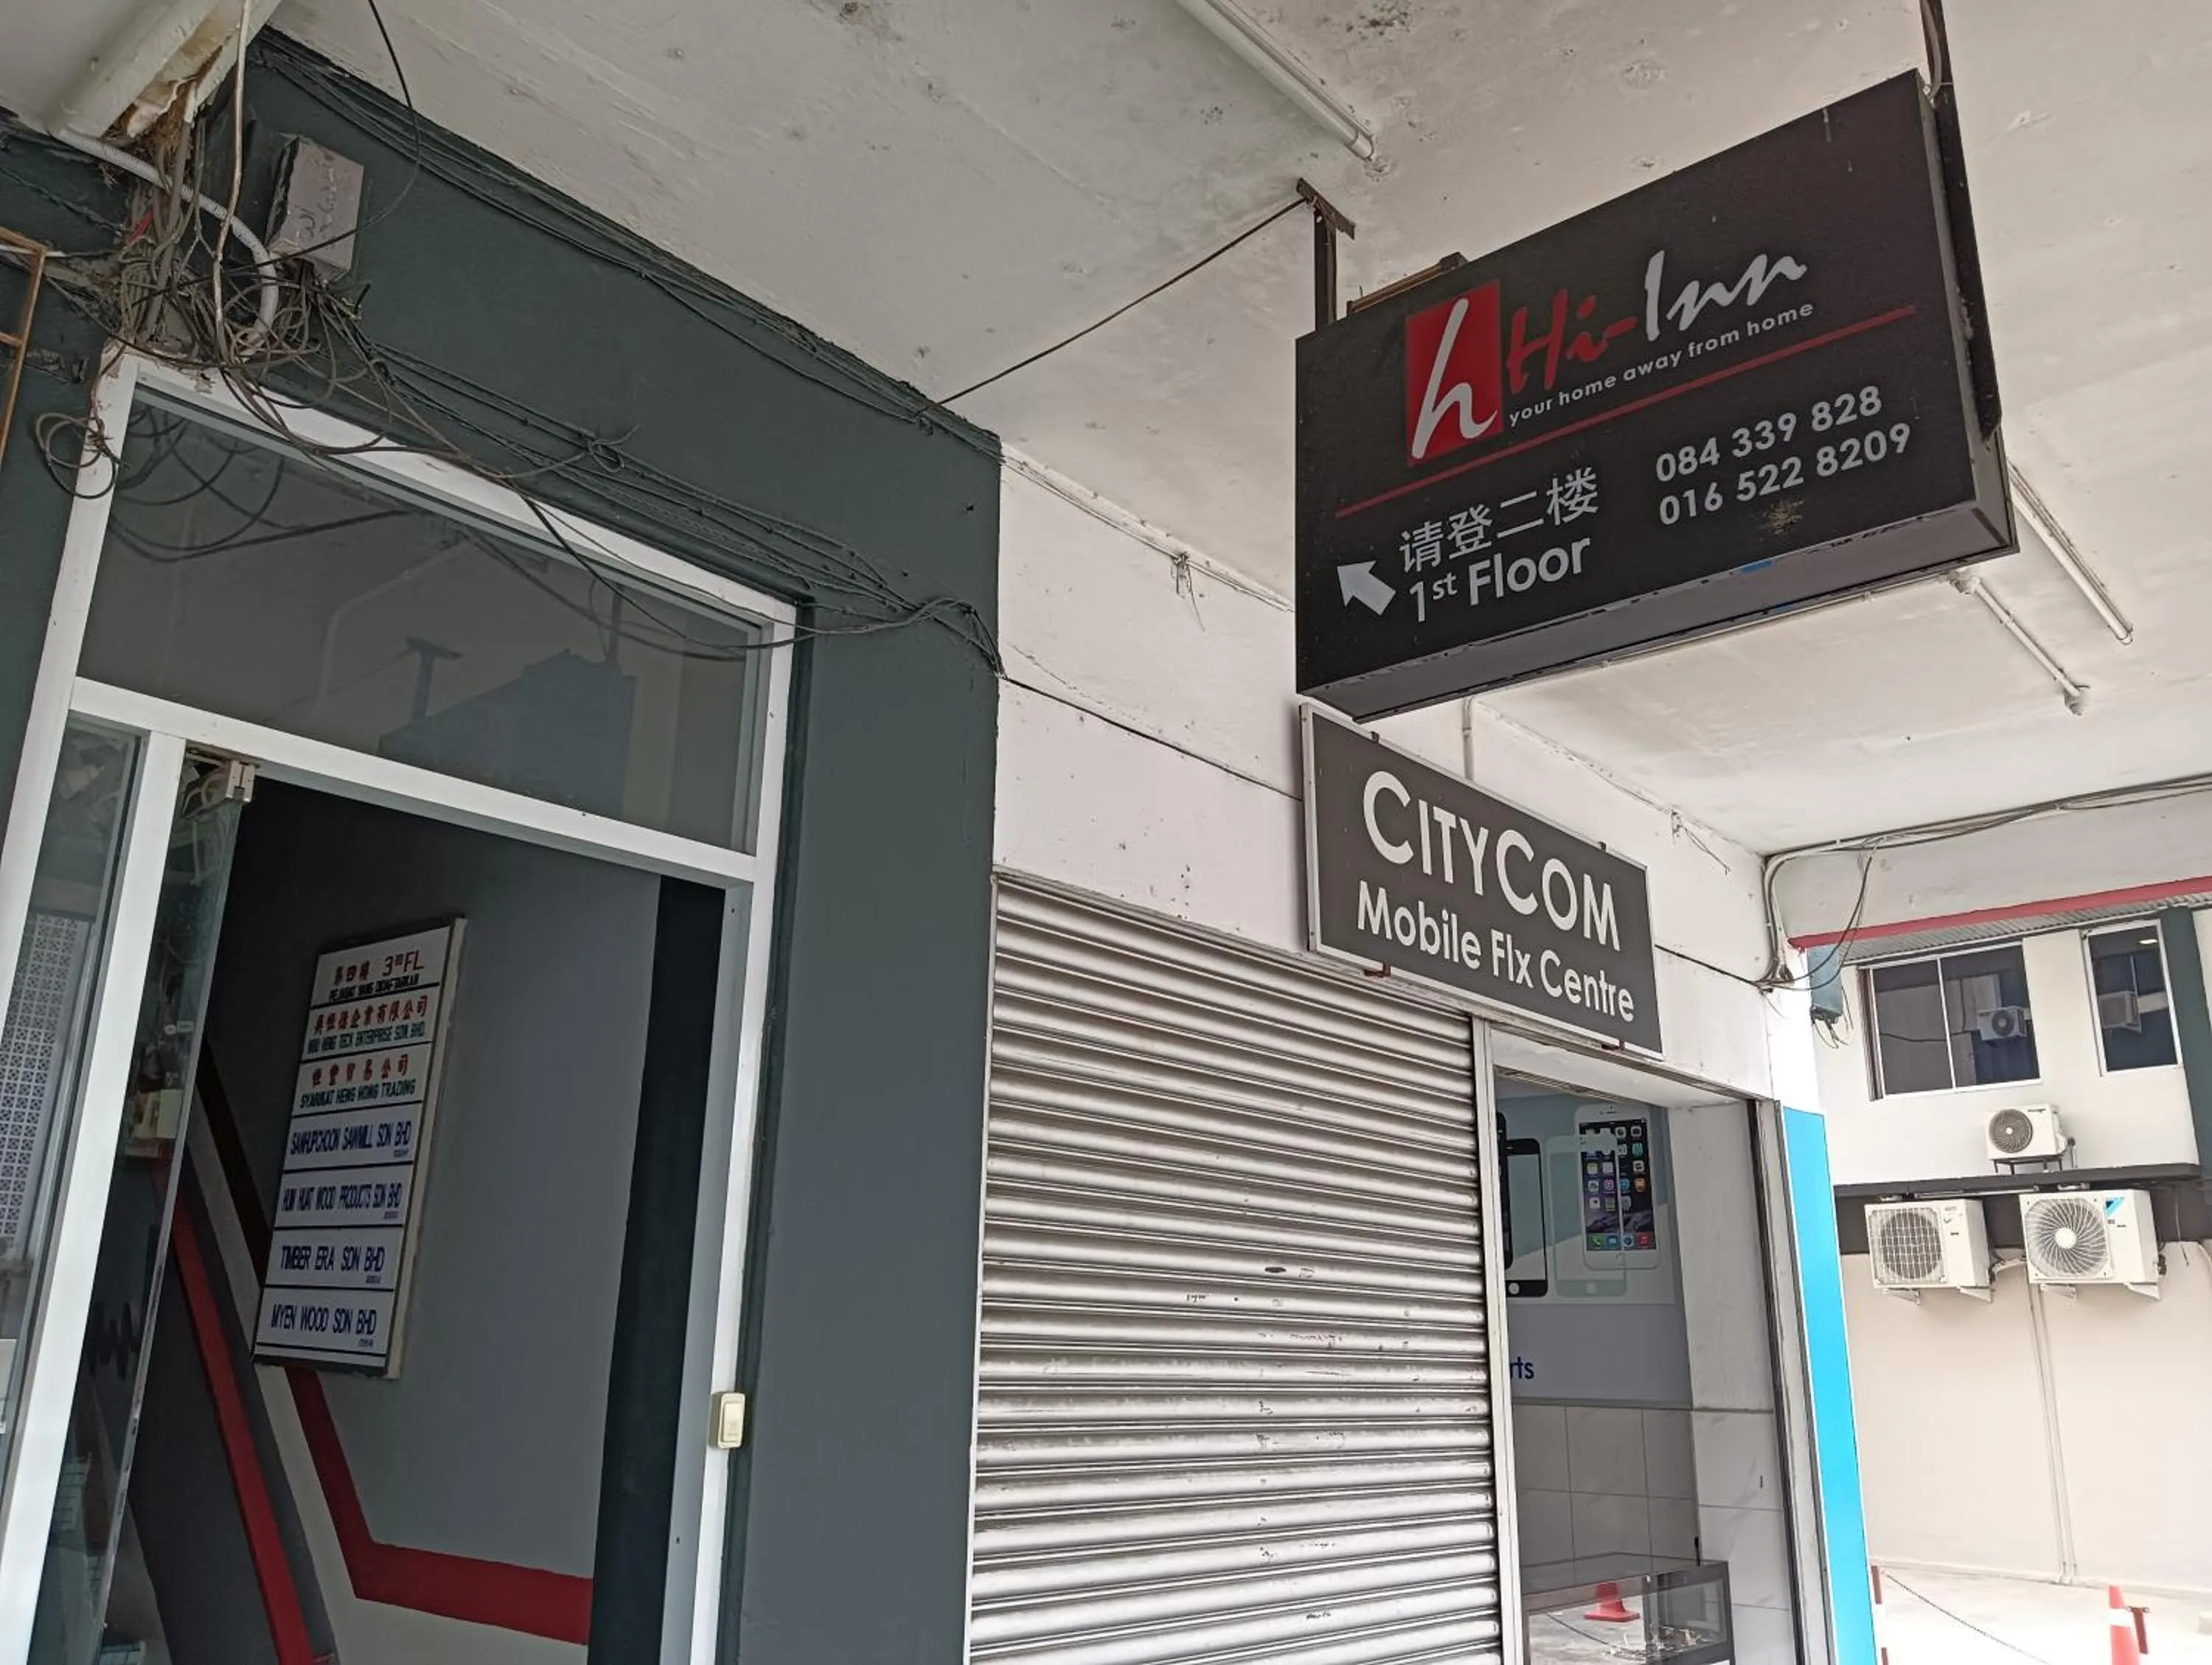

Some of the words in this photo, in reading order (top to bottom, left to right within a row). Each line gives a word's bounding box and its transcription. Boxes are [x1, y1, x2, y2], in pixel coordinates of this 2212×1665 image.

[1509, 397, 1552, 428] your
[1559, 375, 1617, 408] home
[1623, 350, 1682, 382] away
[1688, 330, 1740, 358] from
[1747, 303, 1815, 337] home
[1656, 437, 1720, 482] 084
[1733, 412, 1797, 458] 339
[1811, 386, 1882, 432] 828
[1660, 482, 1723, 525] 016
[1736, 456, 1804, 502] 522
[1816, 423, 1911, 477] 8209
[1399, 467, 1599, 573] 请登二楼
[1410, 571, 1458, 622] 1st
[1468, 538, 1591, 606] Floor
[1357, 880, 1481, 970] Mobile
[1540, 950, 1635, 1023] Centre
[394, 1120, 411, 1147] BHD
[280, 1245, 312, 1271] TIMBER
[314, 1245, 335, 1271] ERA
[340, 1245, 362, 1272] SDN
[364, 1245, 386, 1273] BHD
[299, 1305, 330, 1332] WOOD
[333, 1307, 354, 1335] SDN
[355, 1309, 378, 1335] BHD
